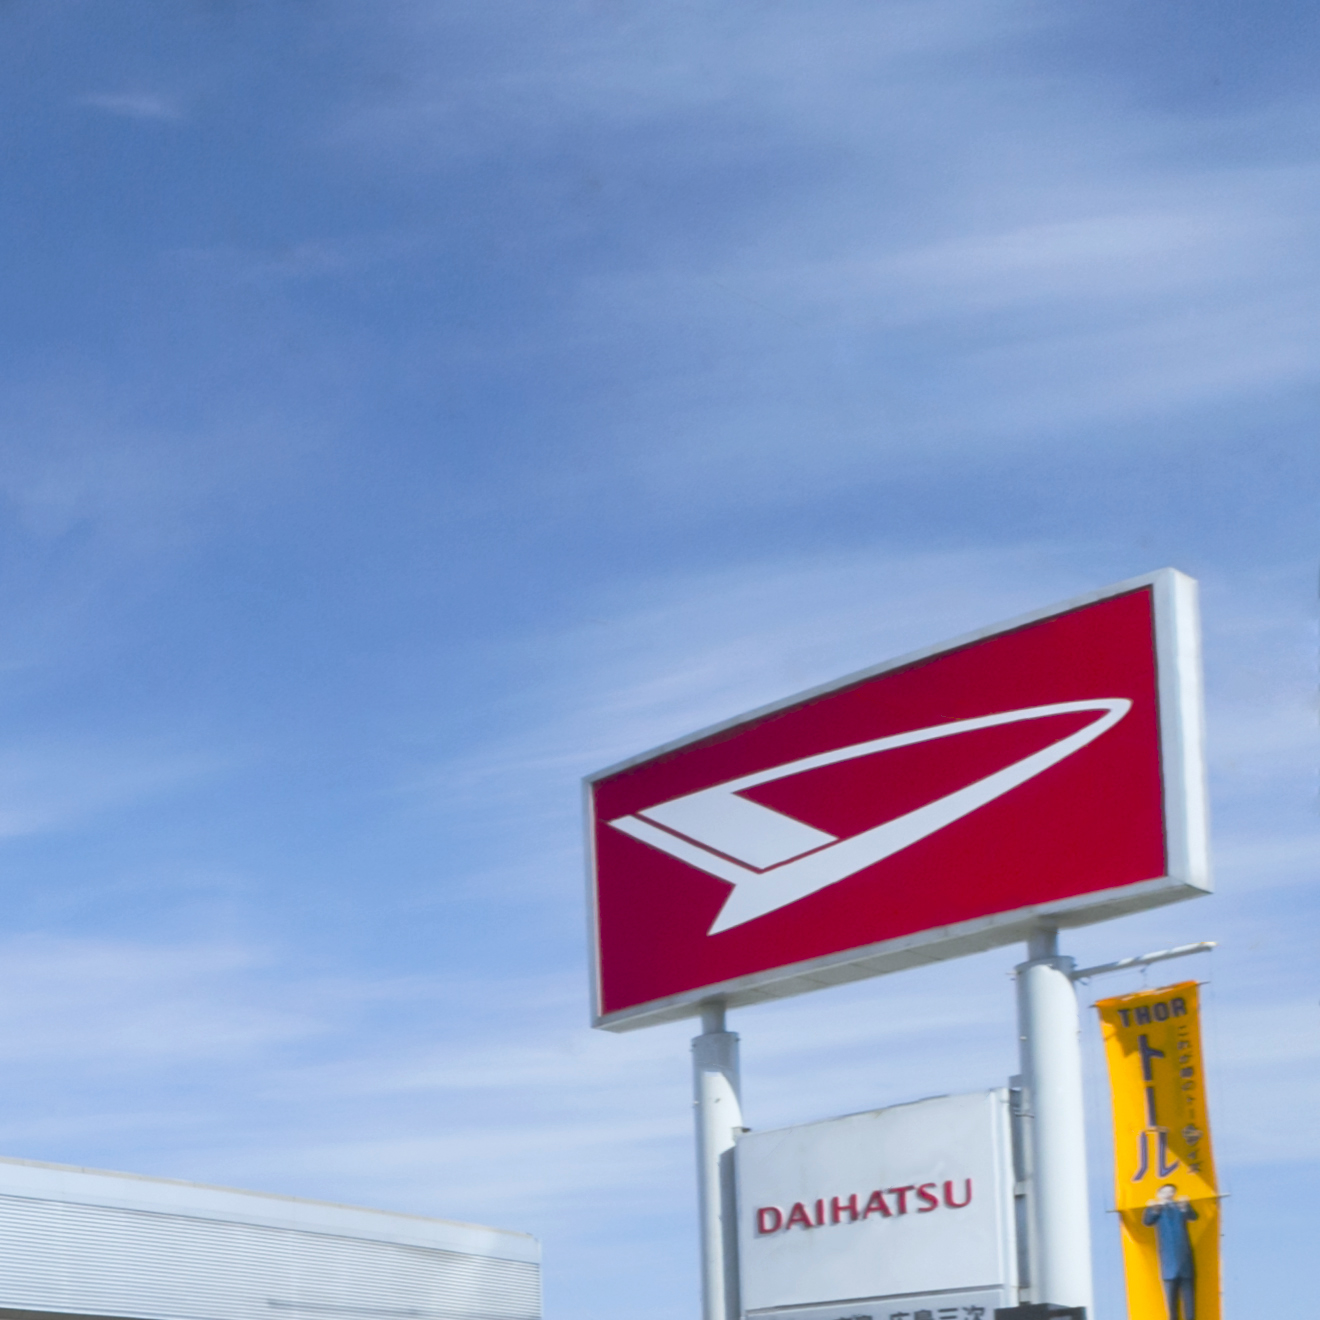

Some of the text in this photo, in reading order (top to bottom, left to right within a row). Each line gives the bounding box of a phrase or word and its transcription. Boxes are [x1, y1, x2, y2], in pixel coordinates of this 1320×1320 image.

[1117, 997, 1187, 1028] THOR
[1131, 1033, 1181, 1183] トール
[755, 1177, 973, 1235] DAIHATSU
